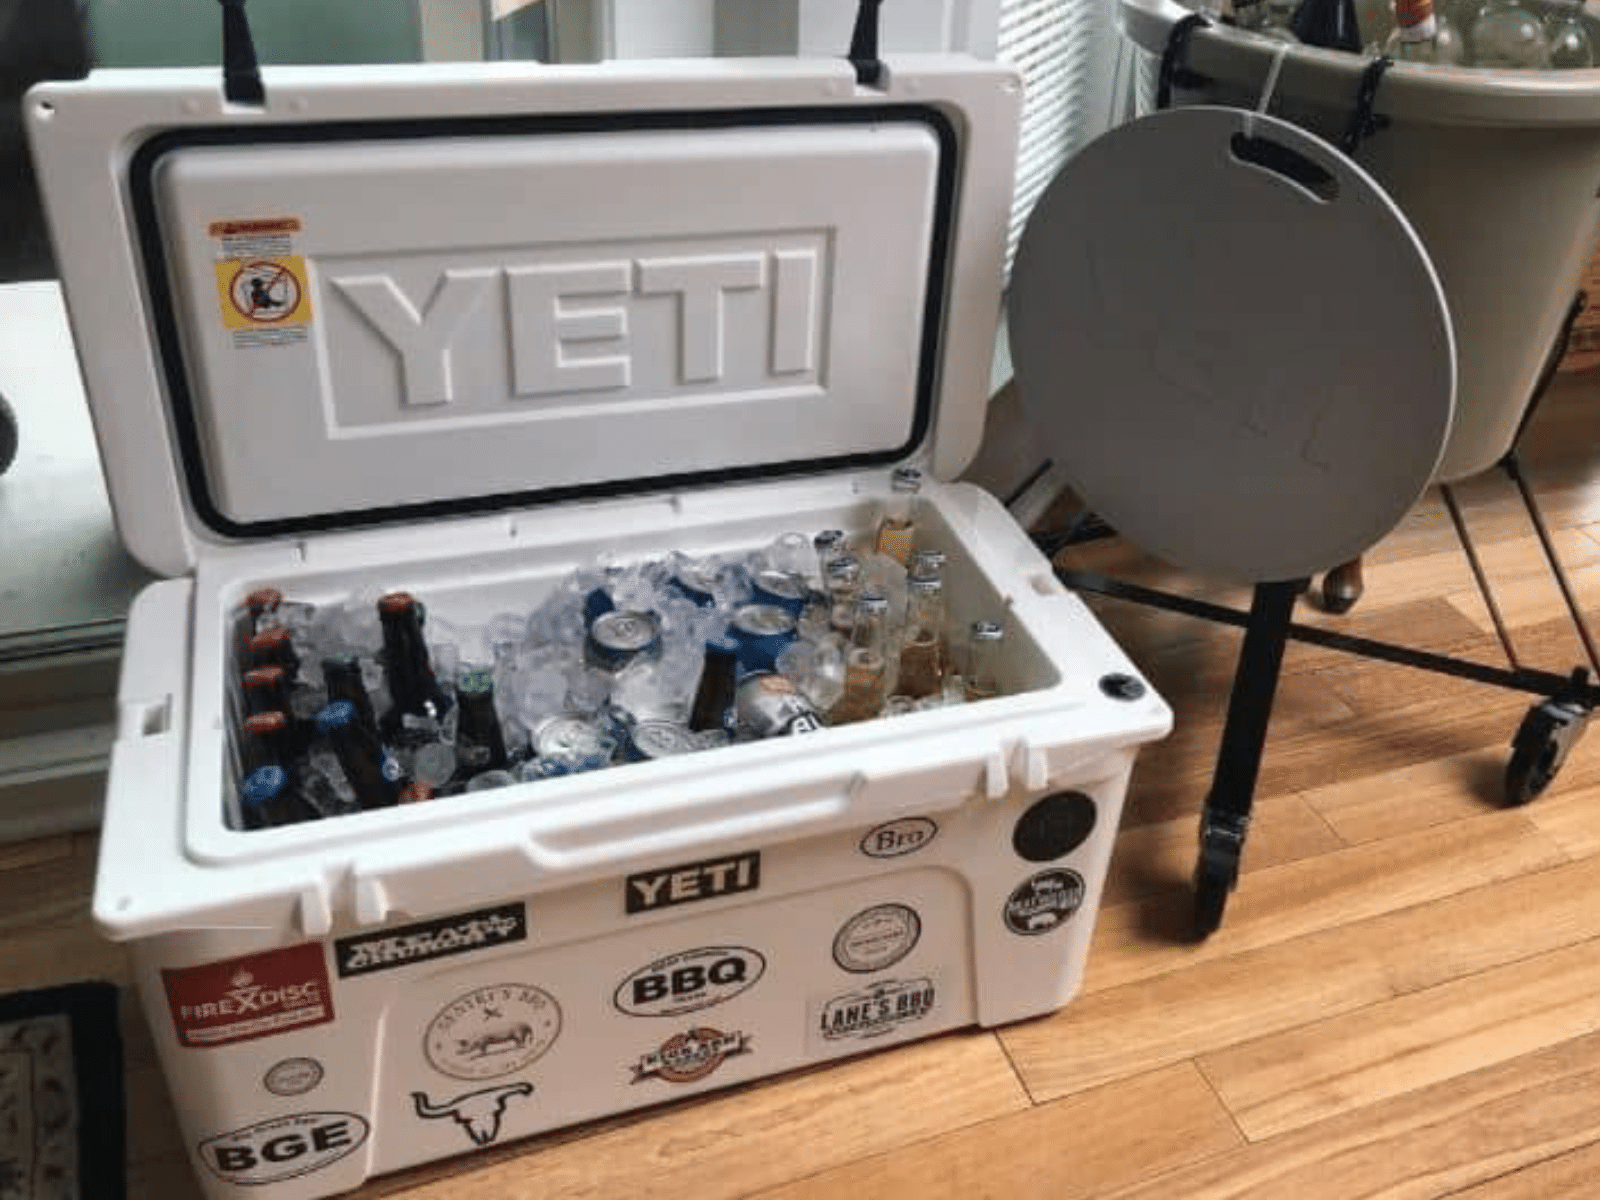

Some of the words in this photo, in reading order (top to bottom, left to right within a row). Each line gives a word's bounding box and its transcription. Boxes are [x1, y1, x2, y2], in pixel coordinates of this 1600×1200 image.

[327, 248, 818, 409] YETI
[876, 829, 925, 851] Bro
[632, 857, 751, 906] YETI
[633, 957, 747, 1006] BBQ
[821, 998, 890, 1031] LANE'S
[215, 1120, 352, 1172] BGE
